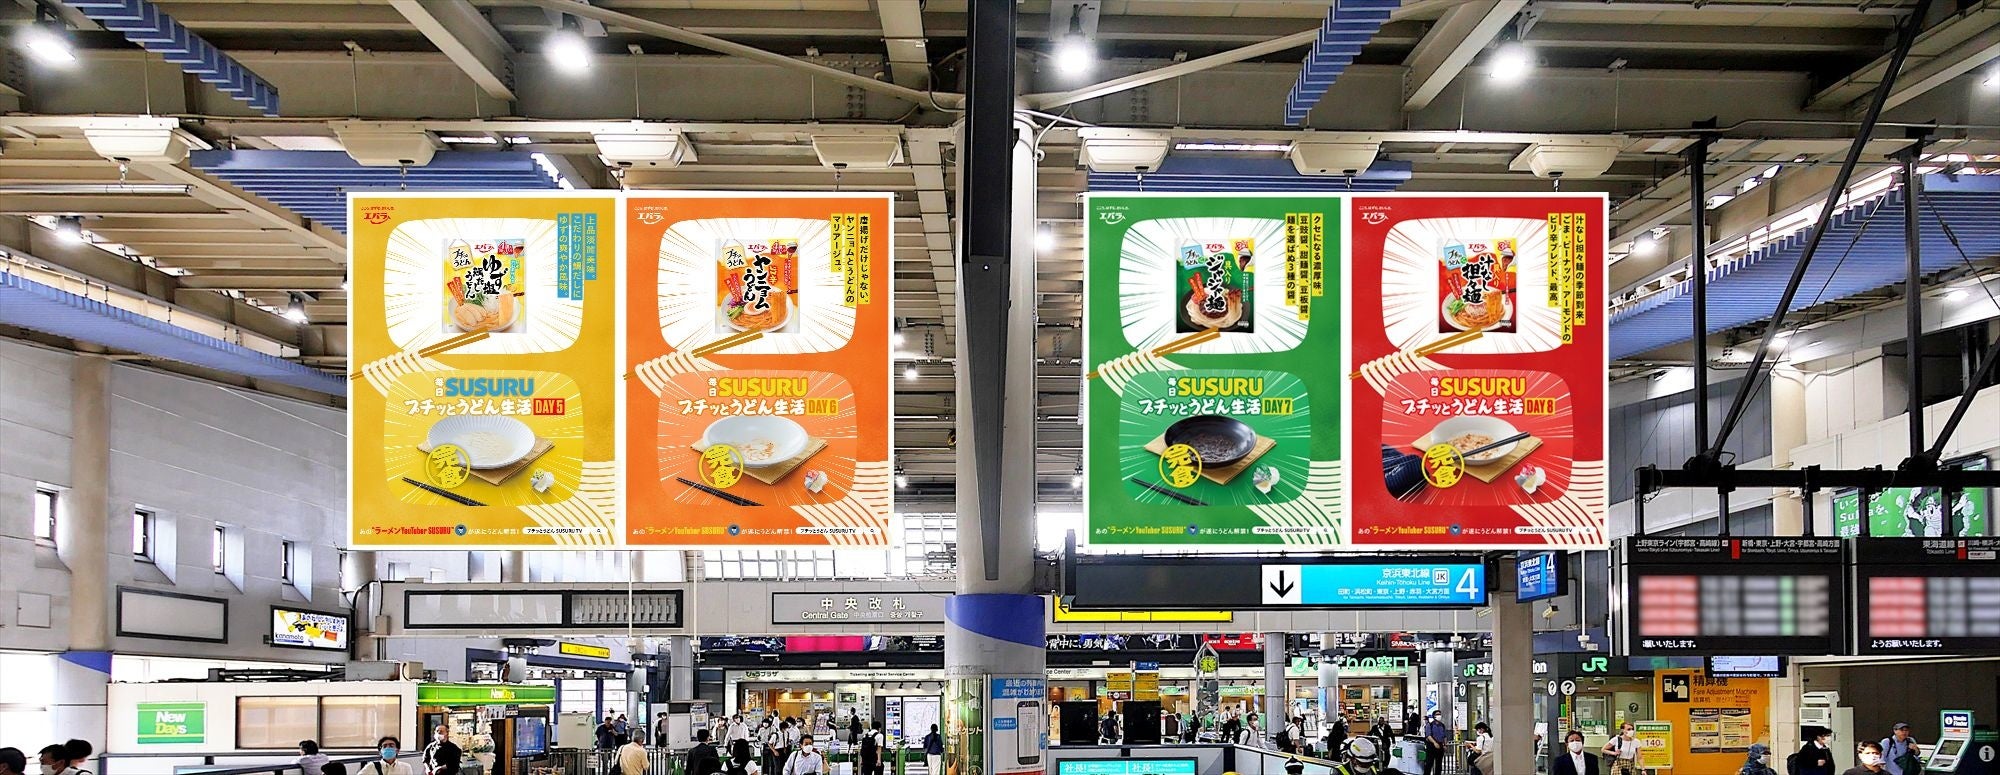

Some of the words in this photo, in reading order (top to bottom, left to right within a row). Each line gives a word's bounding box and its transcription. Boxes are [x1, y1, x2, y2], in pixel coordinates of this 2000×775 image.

[364, 212, 391, 222] エバラ
[637, 212, 664, 222] エバラ
[1099, 212, 1126, 222] エバラ
[1361, 212, 1389, 222] エバラ
[832, 216, 841, 271] マリアージュ。
[846, 216, 855, 303] ヤンニョムとうどんの
[1313, 216, 1322, 295] クセになる濃厚味。
[1549, 215, 1558, 306] ピリ辛ブレンド、最高。
[1480, 254, 1495, 292] 汁なし
[1562, 216, 1571, 342] ごま・ピーナッツ・アーモンドの
[1576, 216, 1584, 324] 汁なし担々麺の季節到来。
[743, 268, 756, 302] うどん
[753, 254, 772, 310] ヤンニョム
[1461, 262, 1484, 304] 担々麺
[445, 378, 534, 397] SUSURU
[718, 377, 808, 397] SUSURU
[1177, 377, 1263, 397] SUSURU
[1440, 377, 1526, 397] SUSURU
[404, 398, 532, 416] プチッとうどん生活
[535, 400, 554, 414] DAY
[556, 400, 563, 414] 5
[678, 398, 806, 416] プチッとうどん生活
[808, 400, 827, 414] DAY
[828, 400, 837, 414] 6
[1138, 398, 1262, 415] プチッとうどん生活
[1264, 399, 1282, 414] DAY
[1283, 399, 1292, 414] 7
[1400, 398, 1524, 416] プチッとうどん生活
[1526, 400, 1544, 414] DAY
[1546, 400, 1554, 414] 8
[1546, 552, 1555, 573] 4
[1382, 568, 1430, 578] 京浜東北線
[1436, 570, 1446, 581] JK
[1455, 568, 1479, 600] 4
[821, 597, 906, 610] 中央改札
[802, 611, 828, 619] Central
[830, 611, 849, 619] Gate
[1642, 640, 1697, 648] 願いいたします。
[1872, 640, 1943, 648] ようお願いいたします。
[1463, 664, 1476, 677] JR
[1532, 660, 1548, 674] ion
[1582, 657, 1608, 672] JR
[1706, 688, 1734, 696] Adjustment
[155, 711, 187, 723] New
[155, 722, 188, 736] Days
